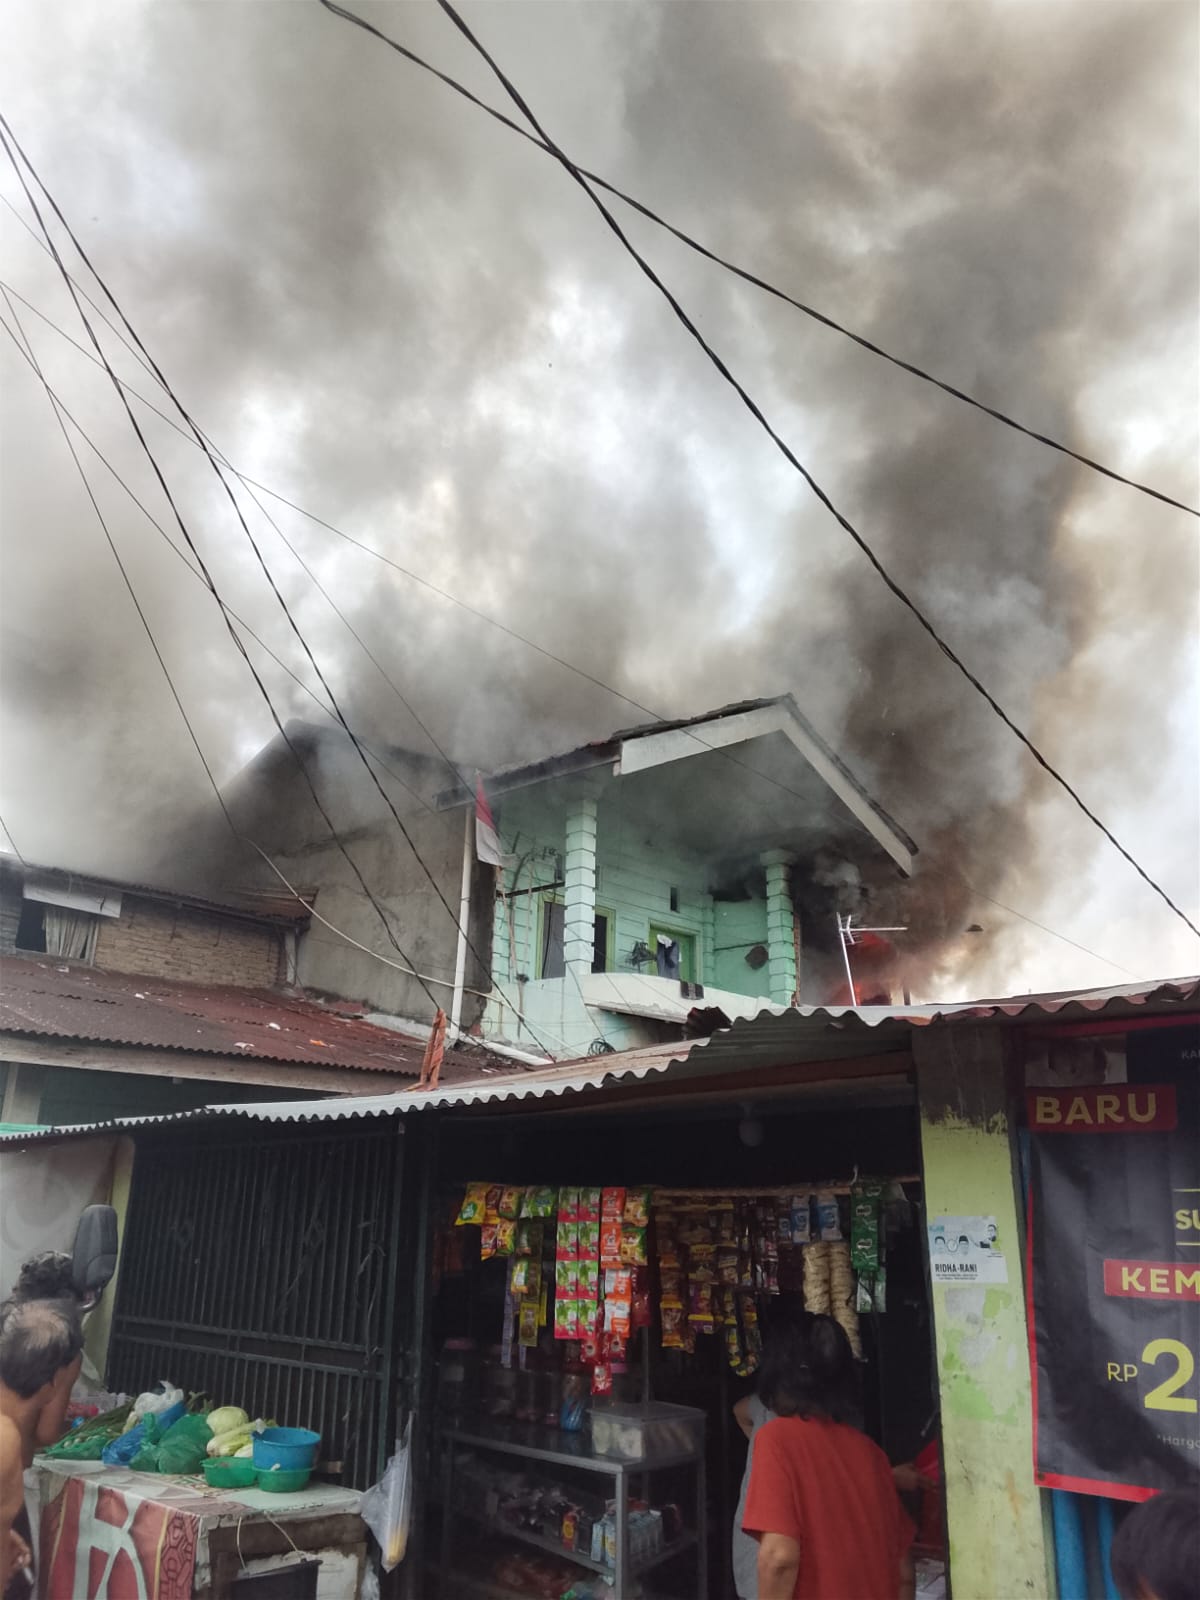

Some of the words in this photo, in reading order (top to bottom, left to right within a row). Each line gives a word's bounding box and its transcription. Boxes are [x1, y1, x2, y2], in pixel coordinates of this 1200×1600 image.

[1181, 1048, 1200, 1060] KA
[1036, 1092, 1157, 1125] BARU
[1121, 1266, 1200, 1295] KEM
[1107, 1361, 1139, 1382] RP
[1141, 1337, 1198, 1413] 2
